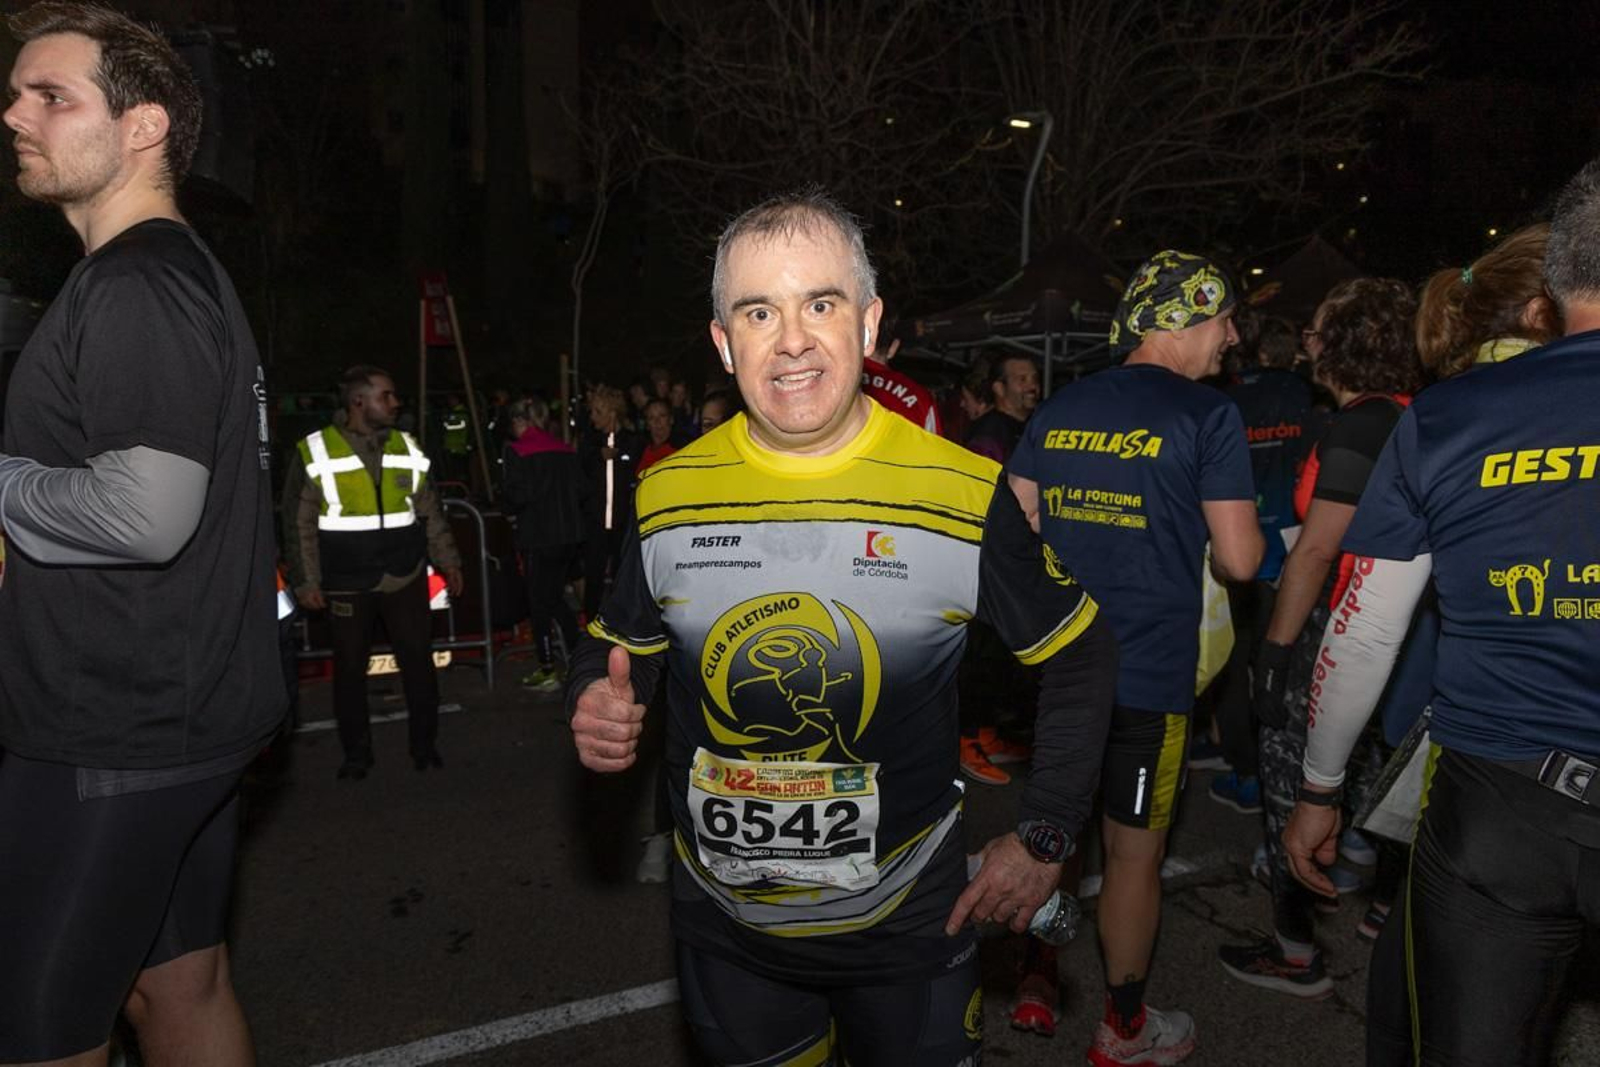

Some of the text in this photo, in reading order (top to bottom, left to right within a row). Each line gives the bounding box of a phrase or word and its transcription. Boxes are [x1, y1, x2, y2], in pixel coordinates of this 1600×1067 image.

[1044, 428, 1163, 459] GESTILASA
[1480, 445, 1600, 488] GEST
[1067, 488, 1082, 500] LA
[1085, 490, 1142, 508] FORTUNA
[691, 535, 742, 549] FASTER
[853, 557, 908, 570] Diputación
[853, 567, 909, 581] de Córdoba
[704, 597, 801, 679] CLUB ATLETISMO
[724, 767, 756, 791] 42
[756, 782, 781, 792] SAN
[702, 797, 860, 846] 6542
[730, 846, 770, 858] FRANCISCO
